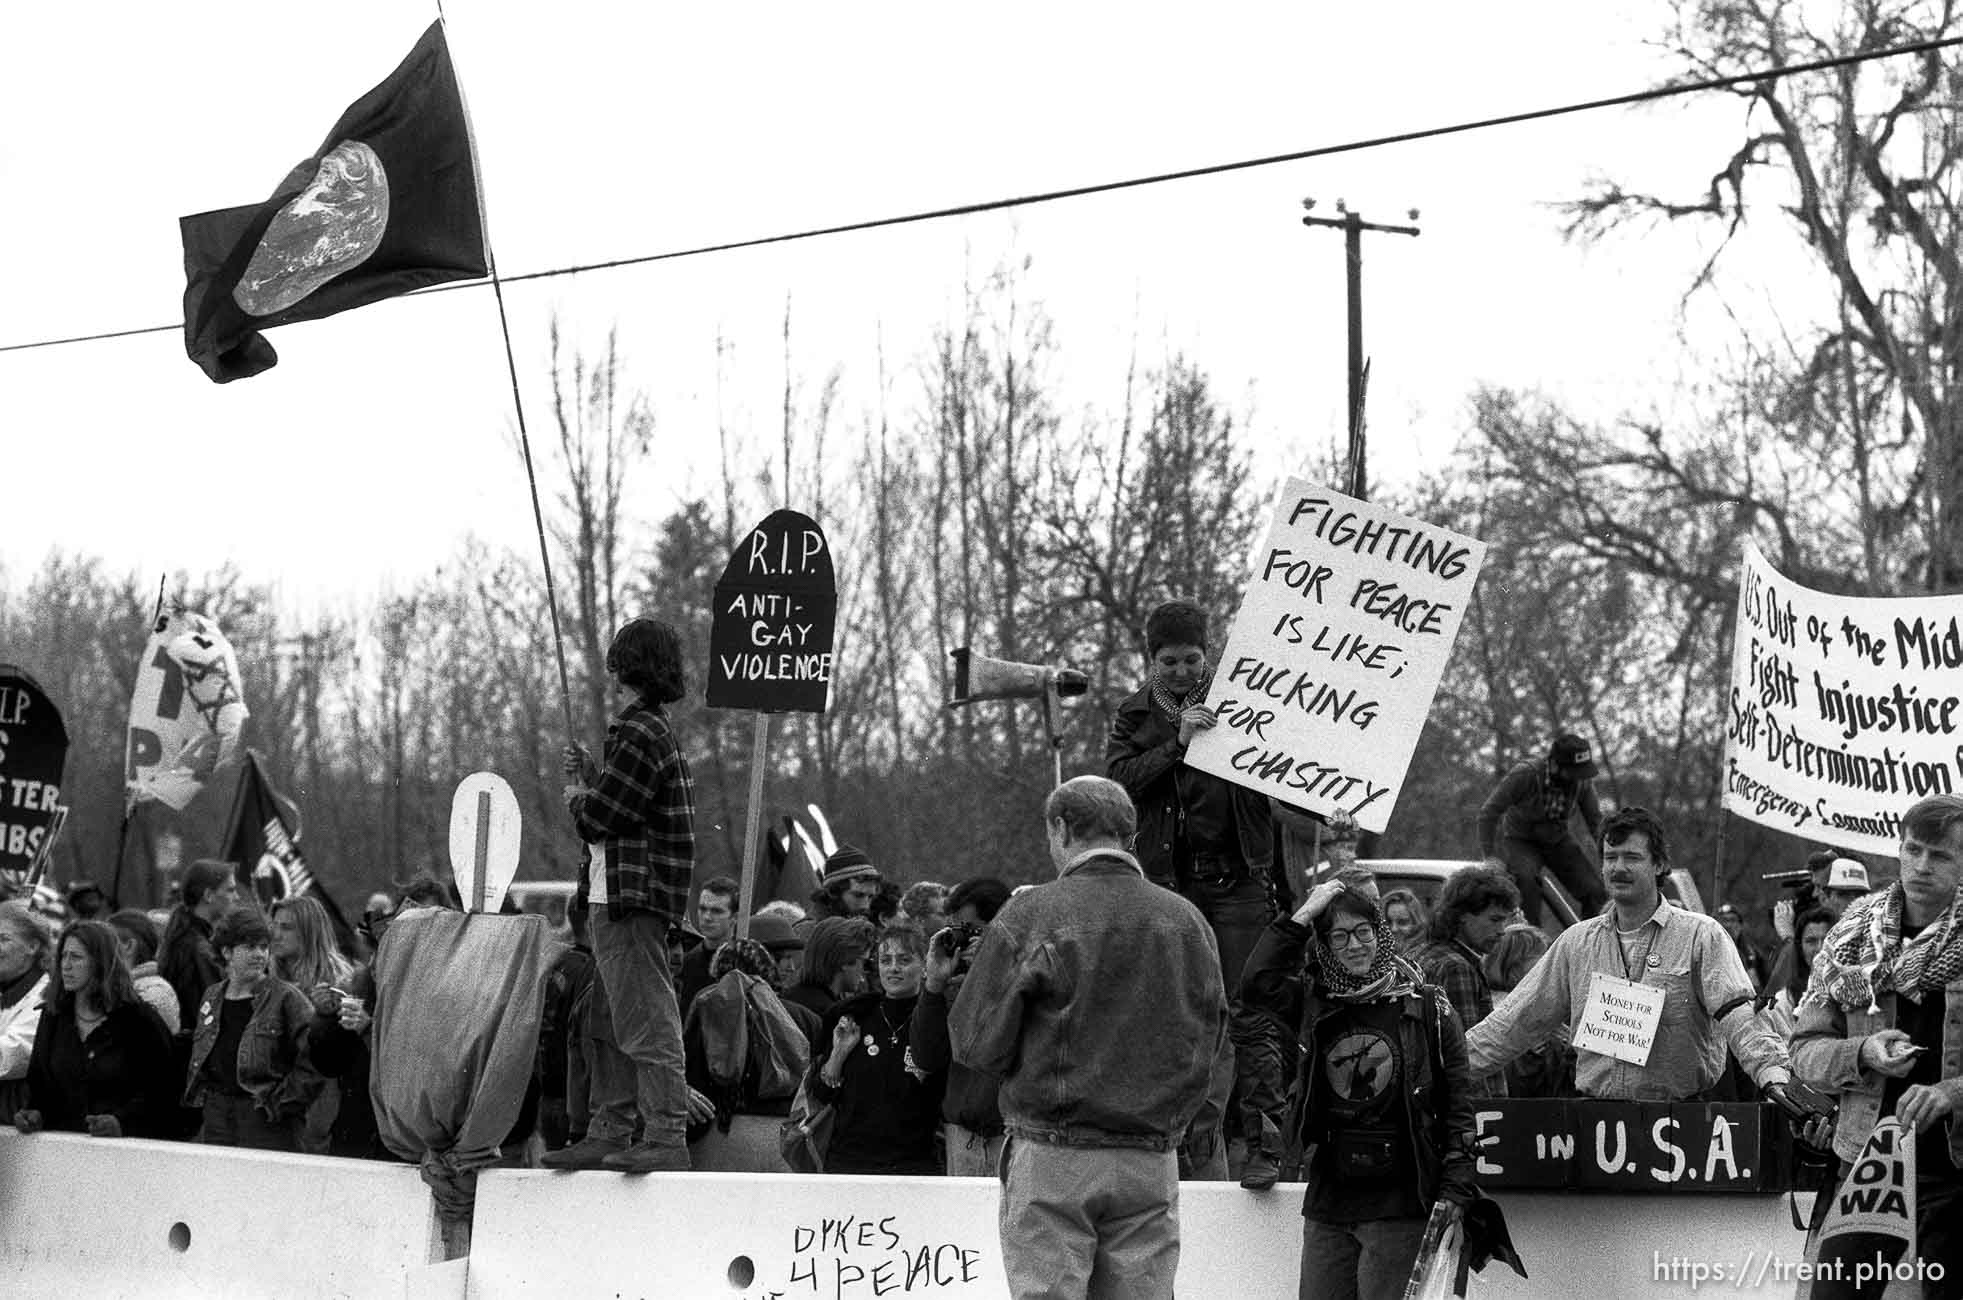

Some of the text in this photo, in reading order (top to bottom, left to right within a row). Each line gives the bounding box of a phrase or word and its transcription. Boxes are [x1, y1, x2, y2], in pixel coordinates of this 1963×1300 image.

[749, 529, 823, 575] R.I.P.
[1289, 498, 1470, 580] FIGHTING
[727, 593, 803, 618] ANTI-
[1263, 548, 1452, 635] FOR PEACE
[751, 620, 813, 646] GAY
[1273, 613, 1408, 679] IS LIKE;
[1767, 586, 1798, 648] Out
[1840, 615, 1886, 666] the
[720, 653, 832, 682] VIOLENCE
[1228, 657, 1379, 731] FUCKING
[1750, 637, 1960, 740] Fight Injustice
[1214, 700, 1275, 742] FOR
[1729, 686, 1952, 798] Self-Determination
[0, 776, 59, 813] TER
[1231, 746, 1390, 817] CHASTITY
[1536, 1134, 1574, 1160] IN
[1596, 1115, 1752, 1182] U.S.A.
[795, 1215, 900, 1254] DYKES
[790, 1257, 817, 1291] 4
